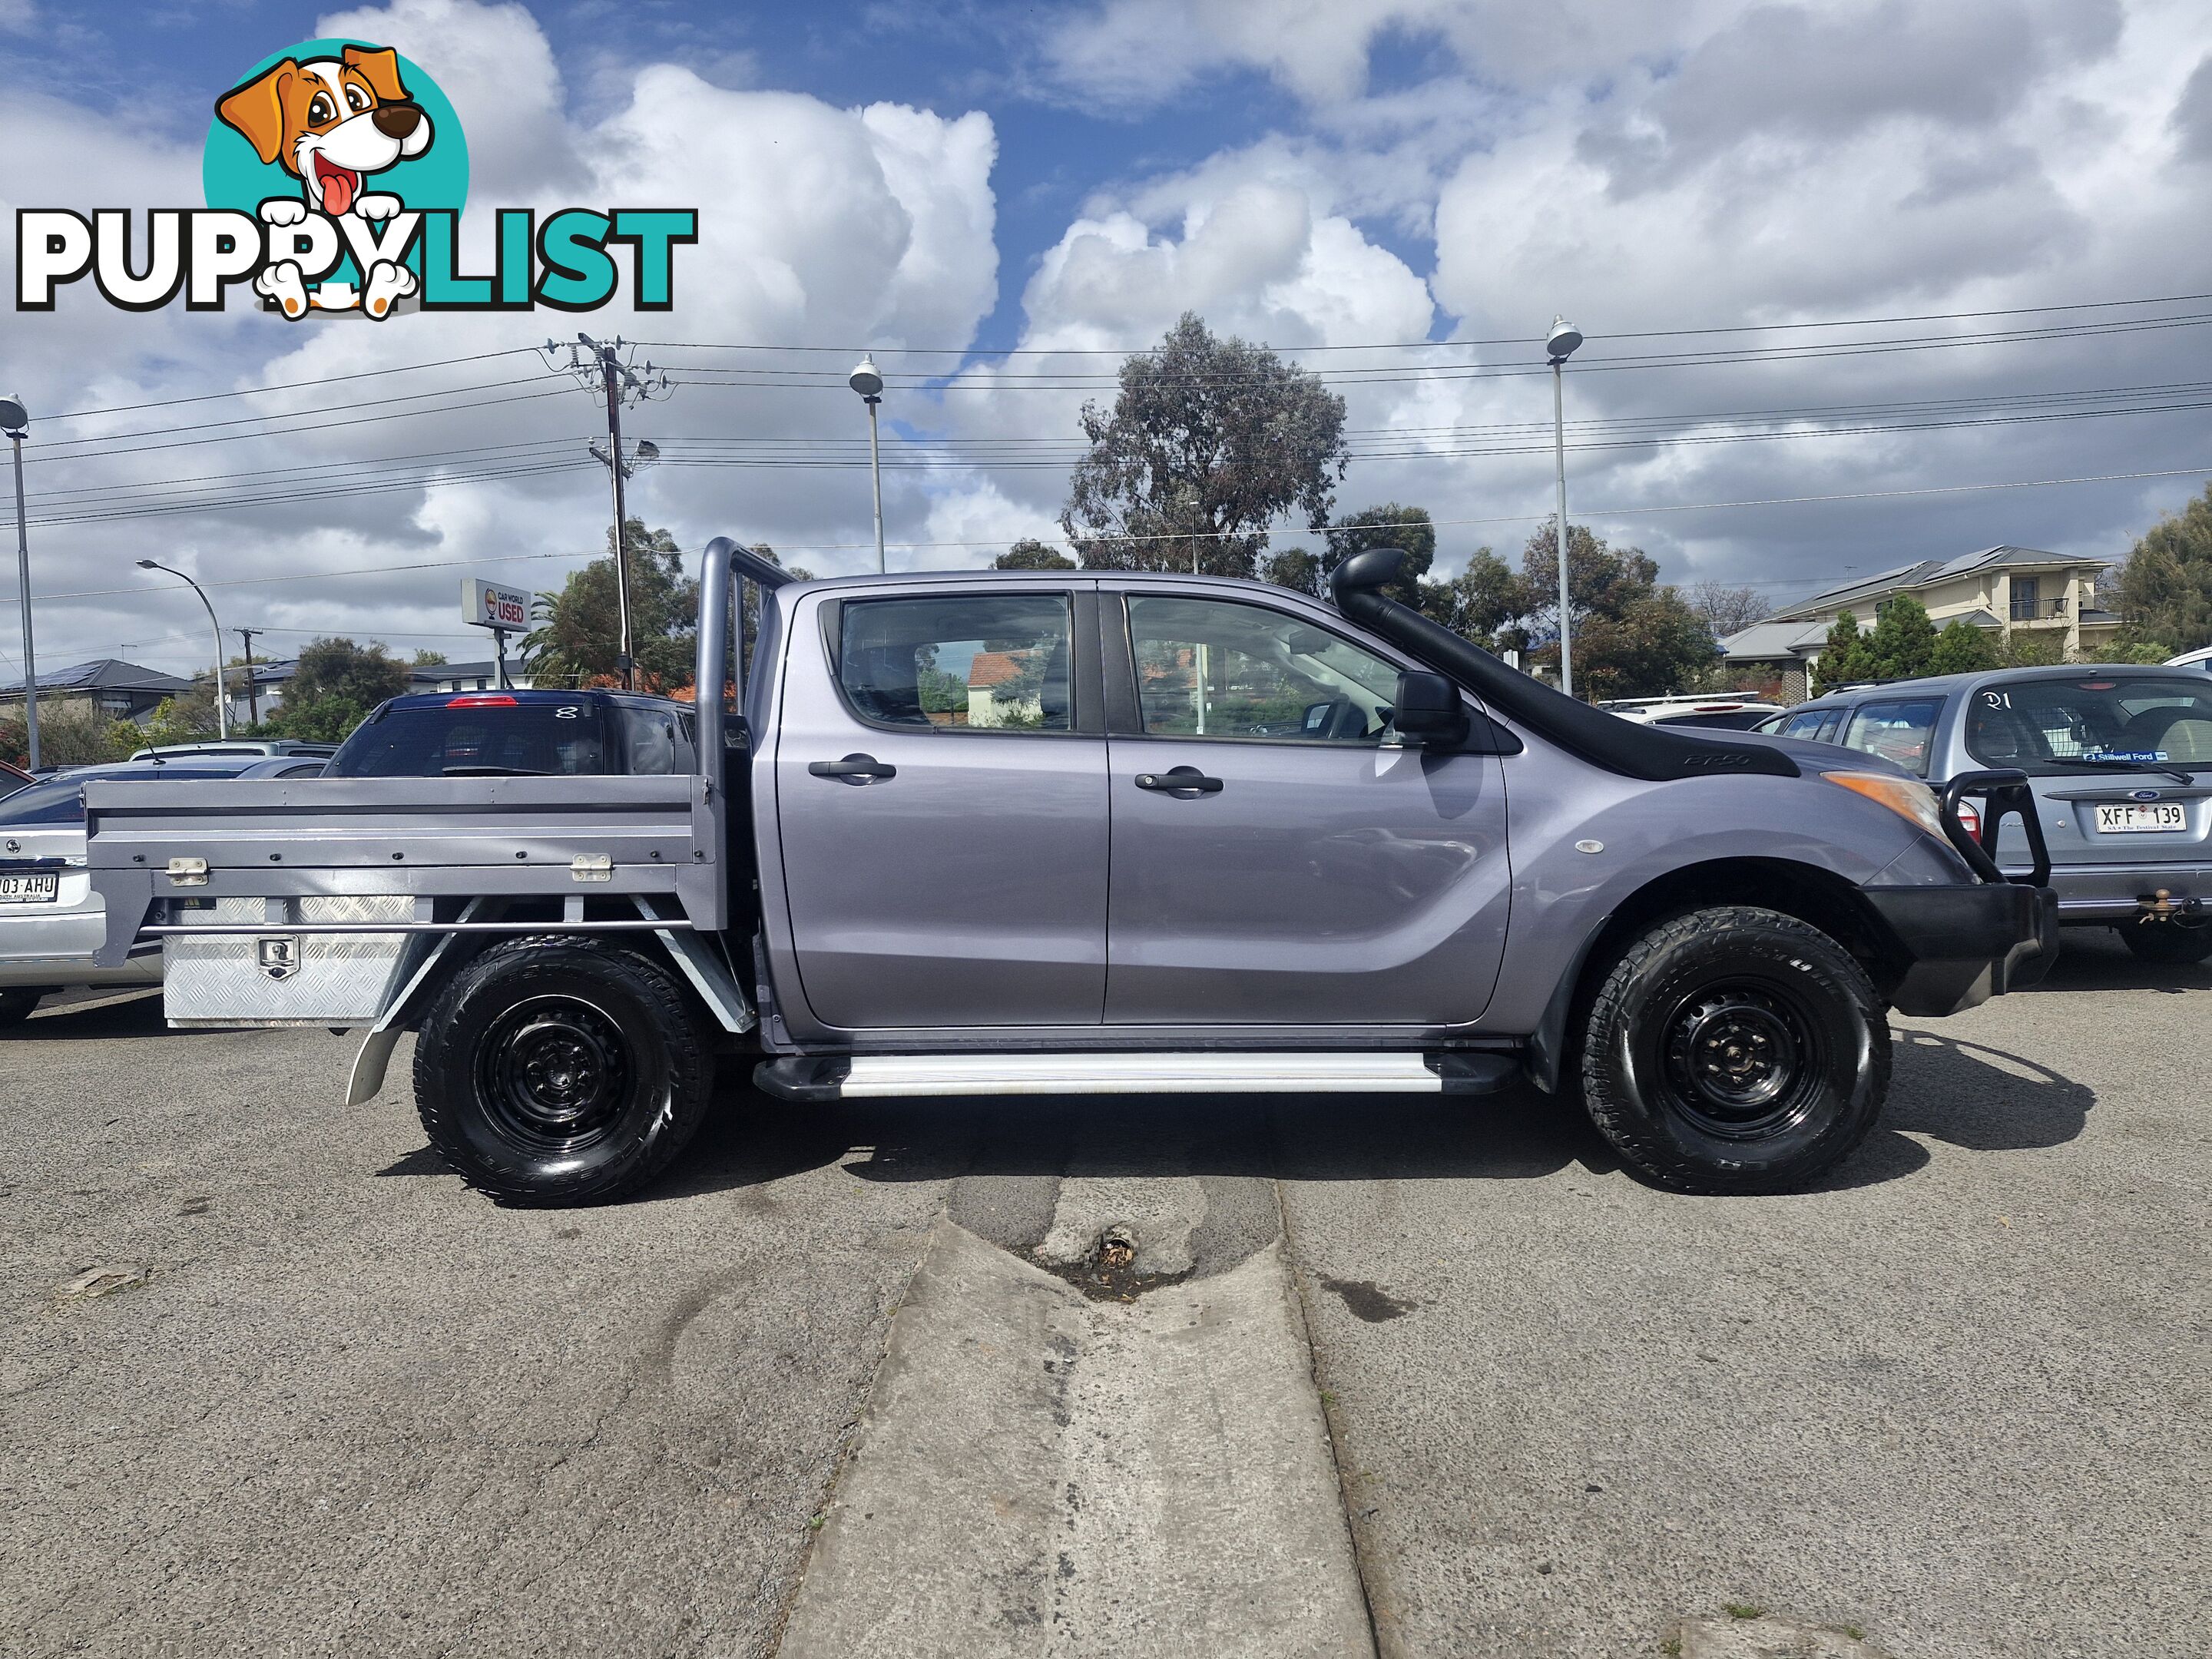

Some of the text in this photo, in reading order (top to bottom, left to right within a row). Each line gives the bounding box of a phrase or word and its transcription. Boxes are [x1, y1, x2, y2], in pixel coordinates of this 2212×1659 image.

[498, 591, 524, 604] CAR WORLD
[498, 601, 524, 624] USED
[555, 707, 578, 719] 8
[2098, 753, 2131, 761] Stillwell
[2132, 752, 2154, 760] Ford
[2101, 806, 2181, 825] XFF 139
